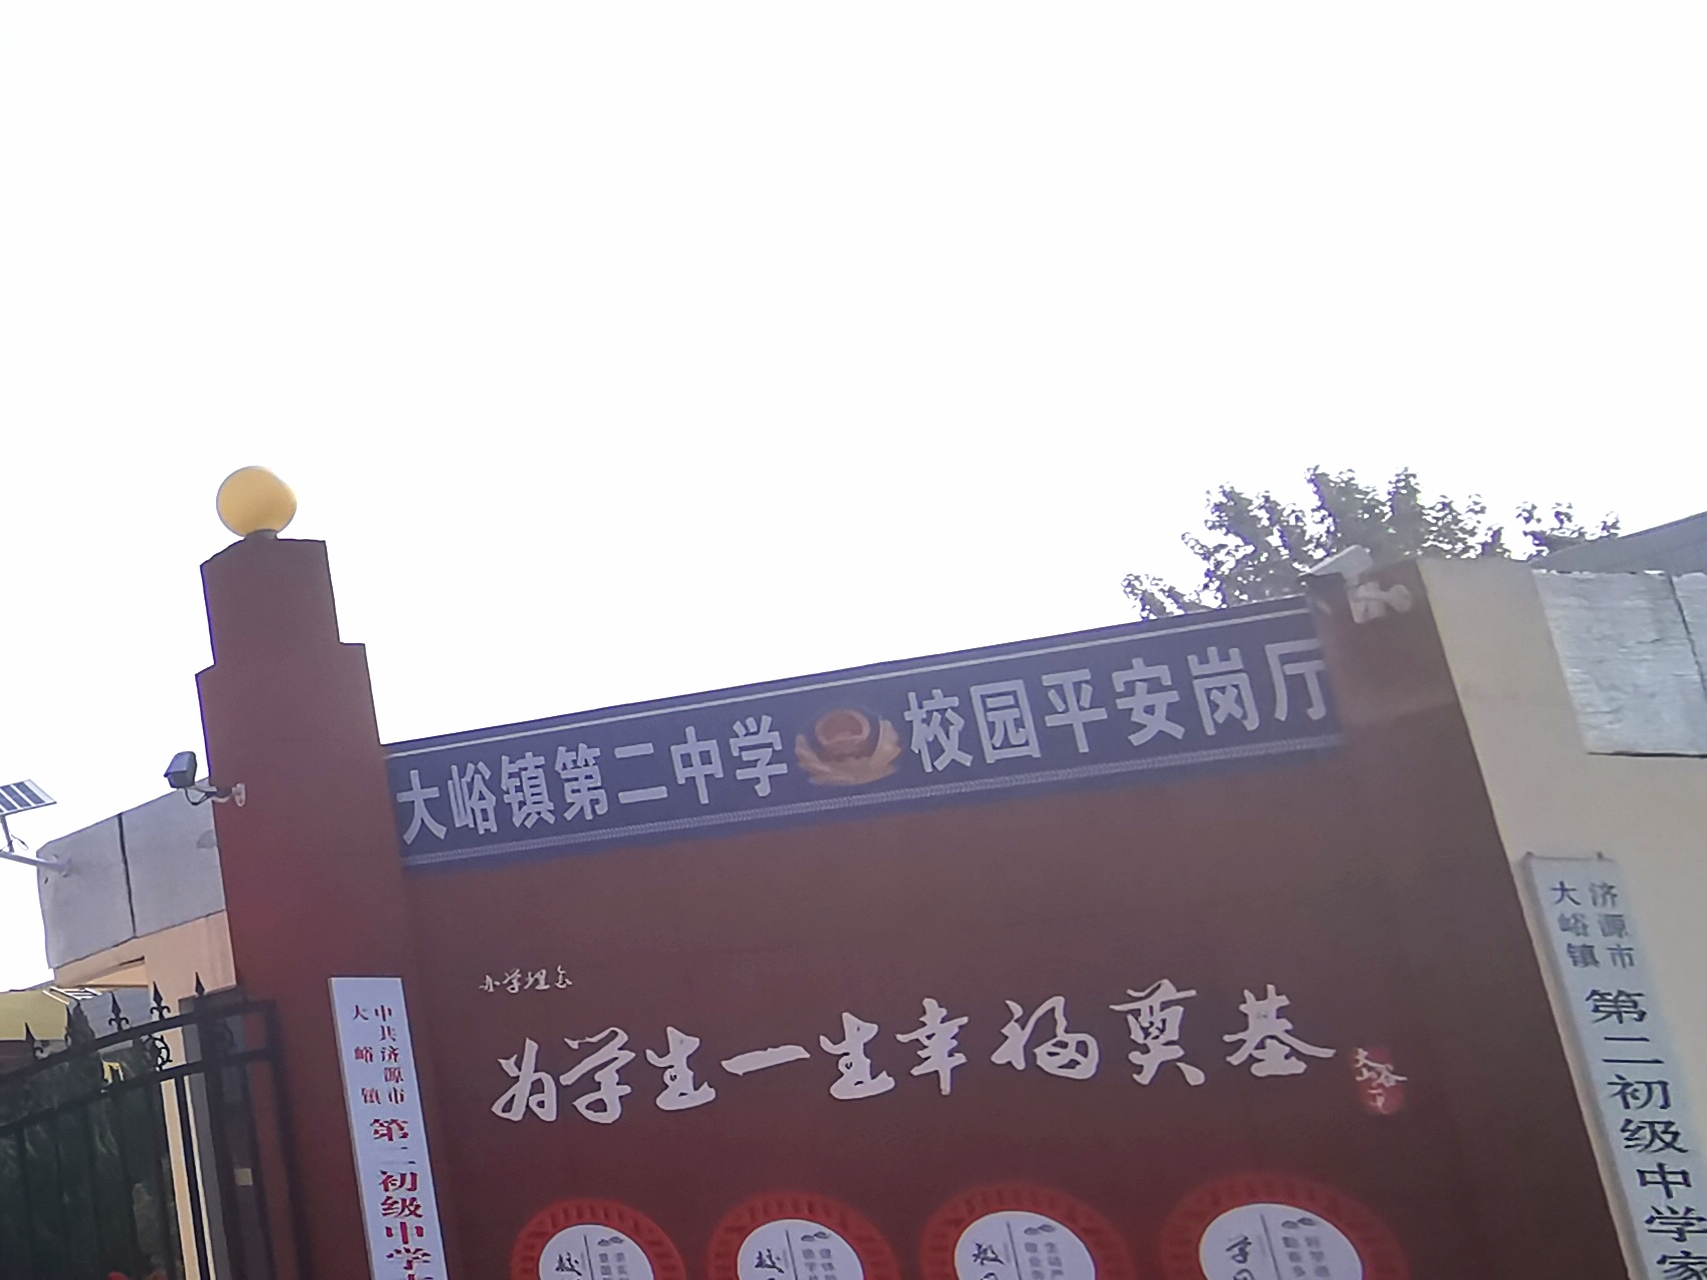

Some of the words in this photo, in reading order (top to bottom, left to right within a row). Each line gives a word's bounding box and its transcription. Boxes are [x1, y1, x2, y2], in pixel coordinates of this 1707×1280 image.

[395, 713, 789, 846] 大峪镇第二中学
[903, 637, 1328, 778] 校园平安岗厅
[1550, 880, 1600, 969] 大峪镇
[1589, 881, 1635, 970] 济源市
[351, 1005, 382, 1106] 大峪镇
[373, 1004, 405, 1106] 中共济源市
[490, 977, 1337, 1124] 为学生一生幸福奠基
